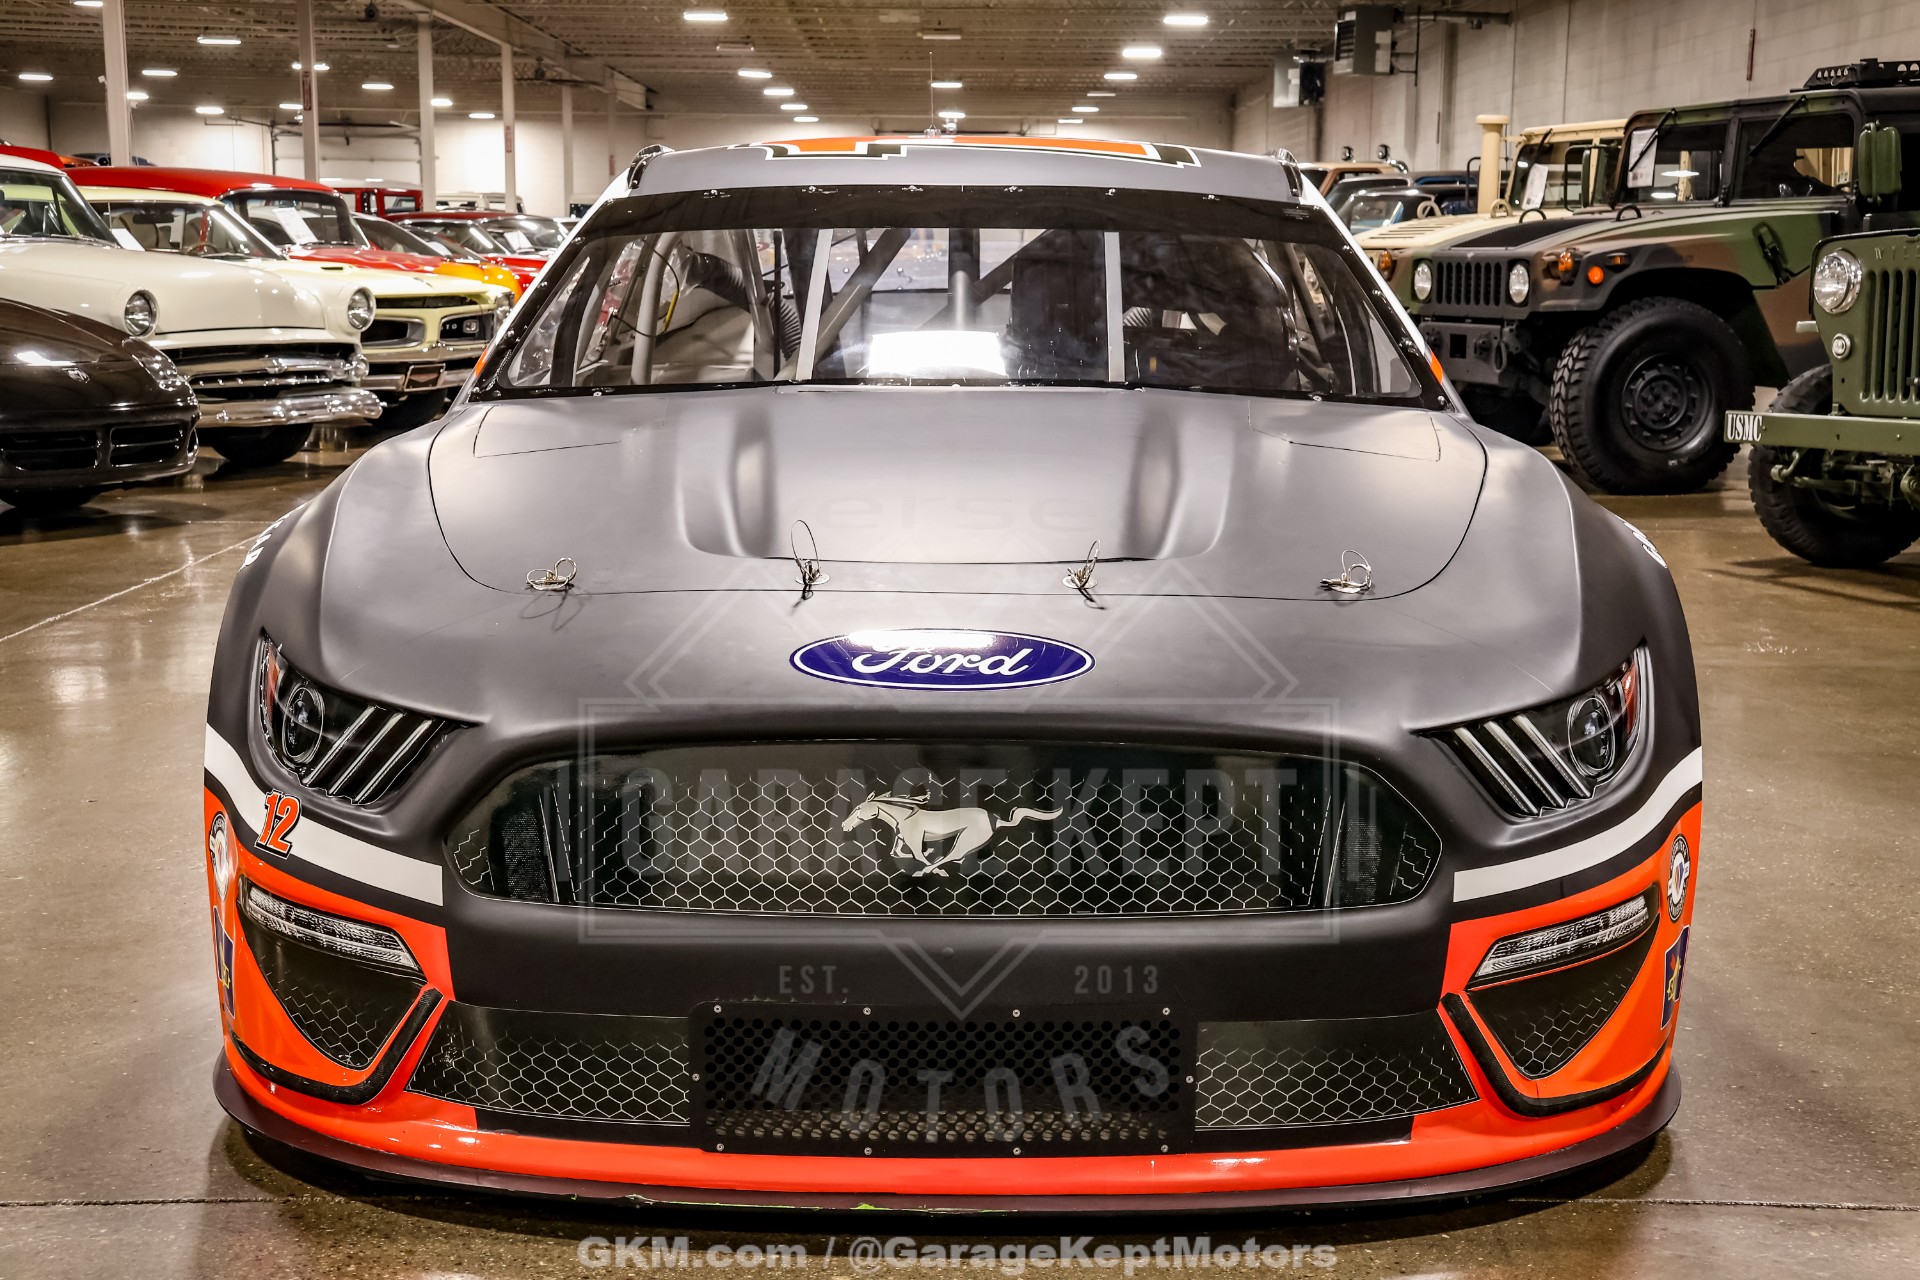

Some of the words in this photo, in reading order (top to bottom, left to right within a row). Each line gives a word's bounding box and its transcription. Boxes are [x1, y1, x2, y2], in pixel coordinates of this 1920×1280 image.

[1727, 413, 1763, 442] USMC
[852, 642, 1034, 676] Ford
[254, 788, 302, 860] 12
